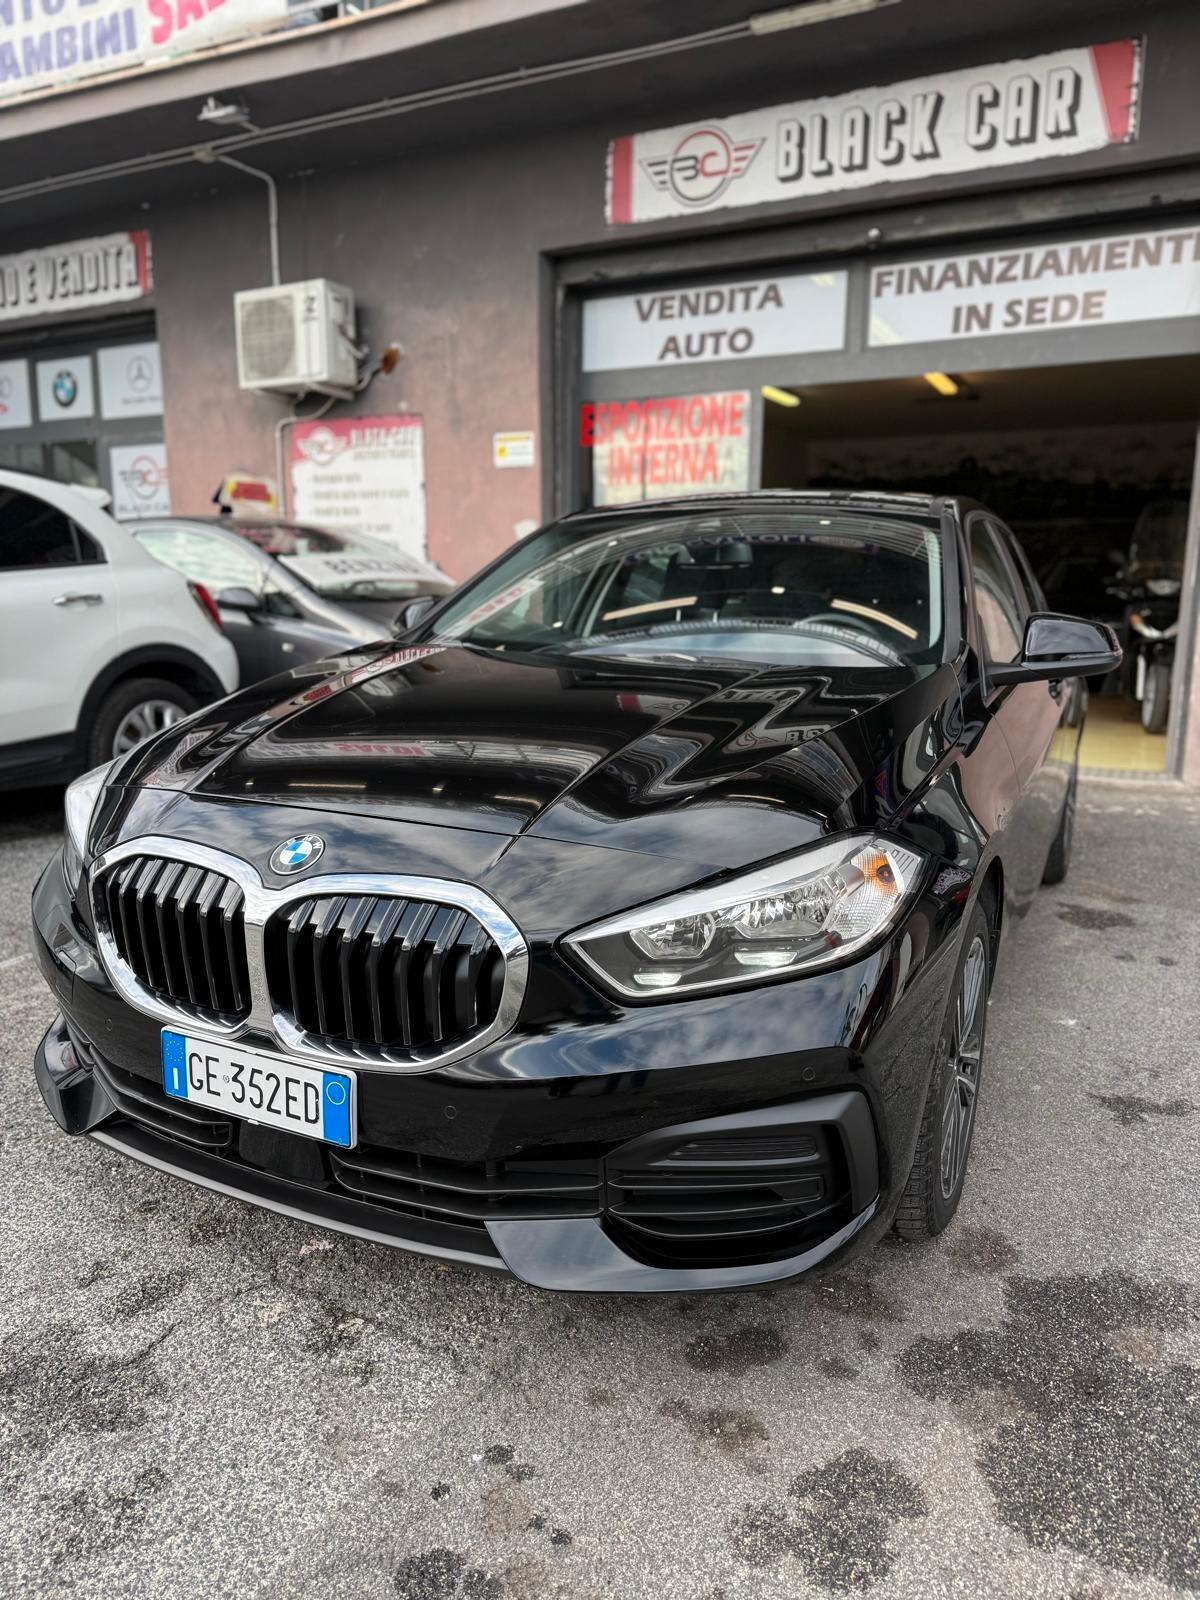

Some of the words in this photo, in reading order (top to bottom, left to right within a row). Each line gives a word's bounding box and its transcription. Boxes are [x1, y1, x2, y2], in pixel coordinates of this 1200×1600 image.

[775, 91, 944, 183] BLACK
[964, 67, 1083, 151] CAR
[43, 244, 139, 300] VENDITA
[633, 283, 783, 323] VENDITA
[951, 304, 994, 334] IN
[1003, 290, 1107, 328] SEDE
[657, 327, 754, 361] AUTO
[579, 394, 745, 449] ESPOSIZIONE
[607, 441, 720, 487] INTERNA
[188, 1052, 221, 1097] GE
[230, 1062, 320, 1124] 352ED
